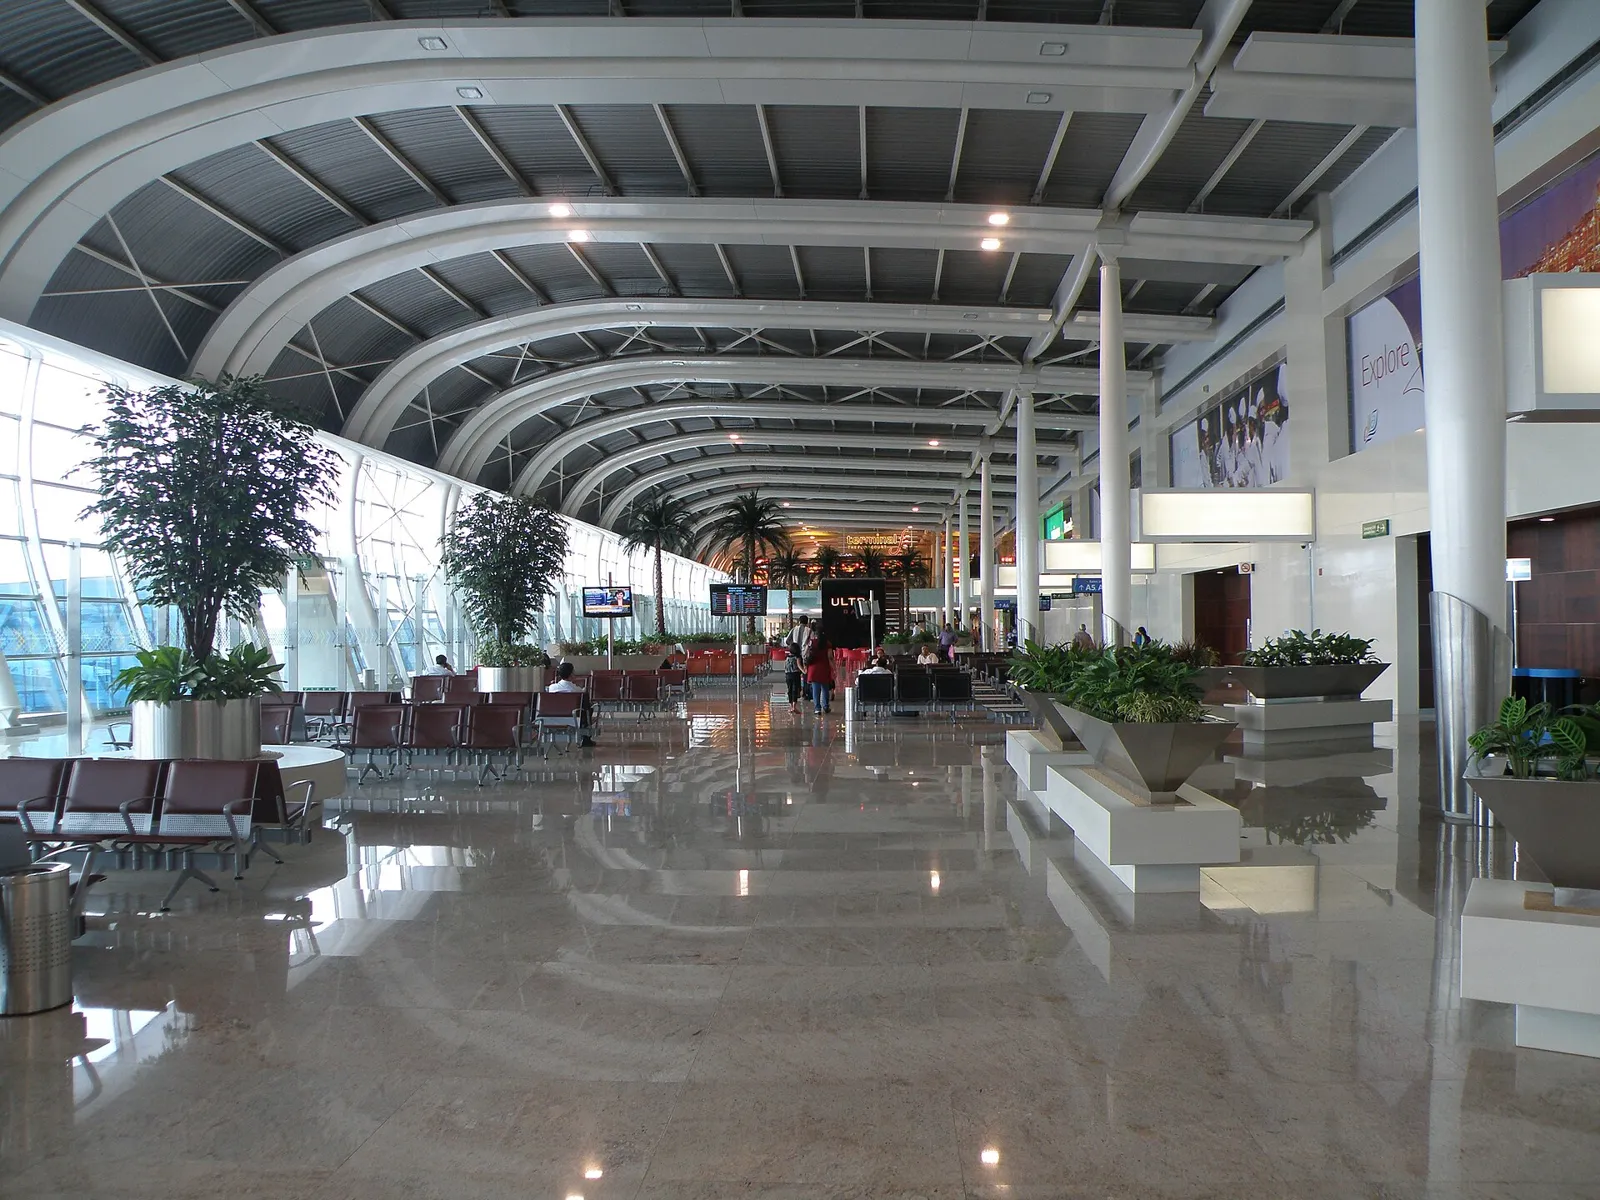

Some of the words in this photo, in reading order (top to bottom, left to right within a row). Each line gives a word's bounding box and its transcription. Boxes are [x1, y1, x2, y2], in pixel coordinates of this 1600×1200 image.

[1361, 342, 1410, 389] Explore
[846, 533, 899, 545] terminal
[831, 597, 872, 607] ULT
